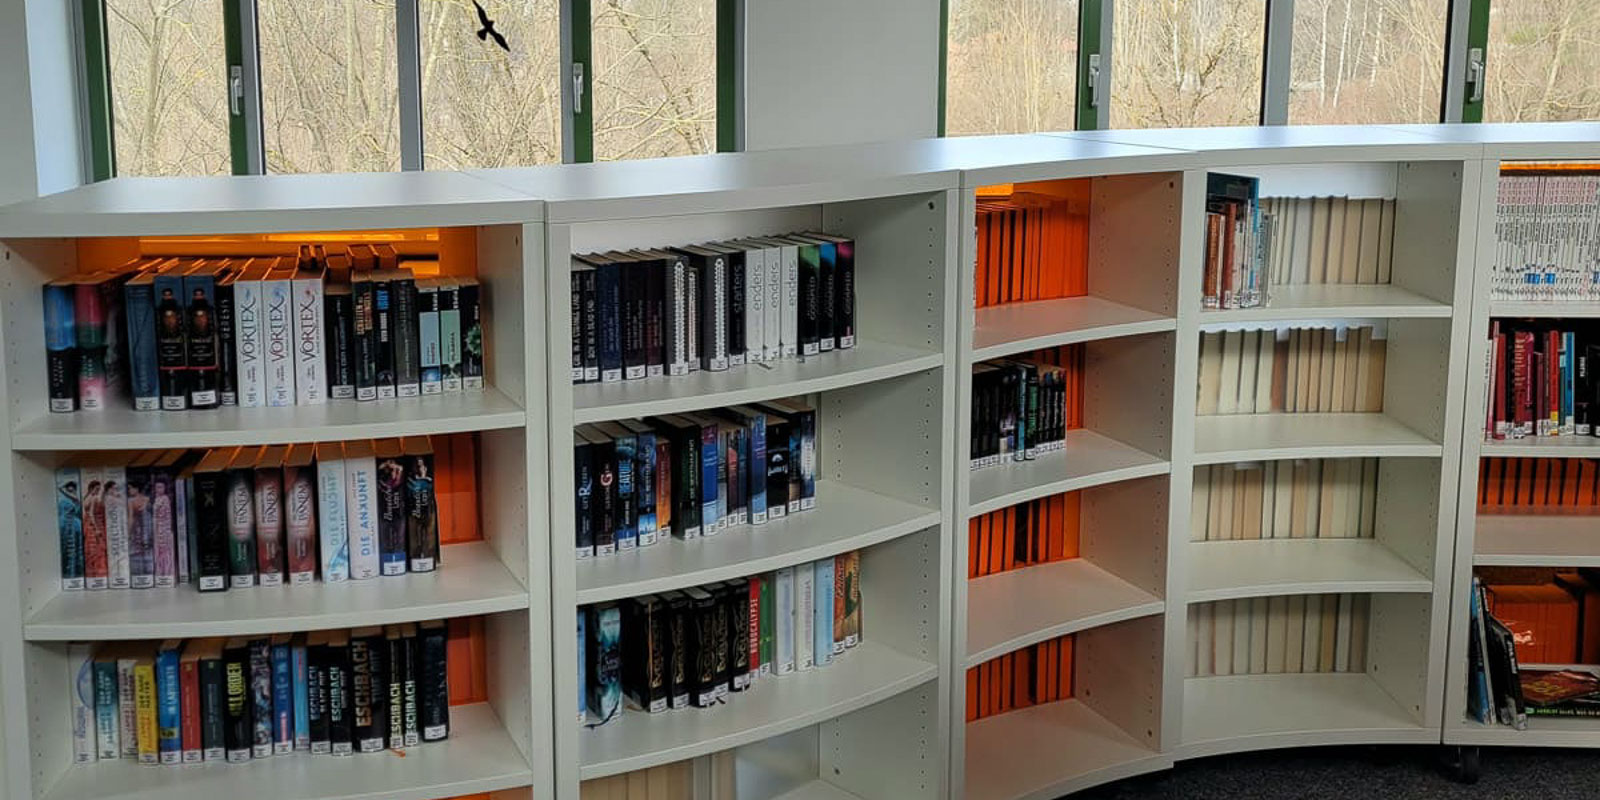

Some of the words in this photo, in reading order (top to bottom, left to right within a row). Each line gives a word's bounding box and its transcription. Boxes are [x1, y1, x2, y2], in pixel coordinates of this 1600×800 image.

[734, 264, 743, 313] starters
[752, 264, 761, 311] enders
[769, 262, 778, 308] enders
[241, 296, 257, 364] VORTEX
[269, 297, 285, 362] VORTEX
[300, 295, 315, 362] VORTEX
[237, 485, 249, 525] PANEM
[265, 484, 278, 523] PANEM
[328, 476, 339, 522] FLUCHT
[357, 471, 369, 530] ANKUNFT
[330, 527, 339, 546] DIE
[360, 536, 371, 556] DIE
[228, 662, 243, 696] ORDER
[309, 666, 320, 720] ESCHBACH
[330, 666, 342, 722] ESCHBACH
[352, 641, 372, 727] ESCHBACH
[390, 683, 401, 738] ESCHBACH
[405, 680, 417, 735] ESCHBACH
